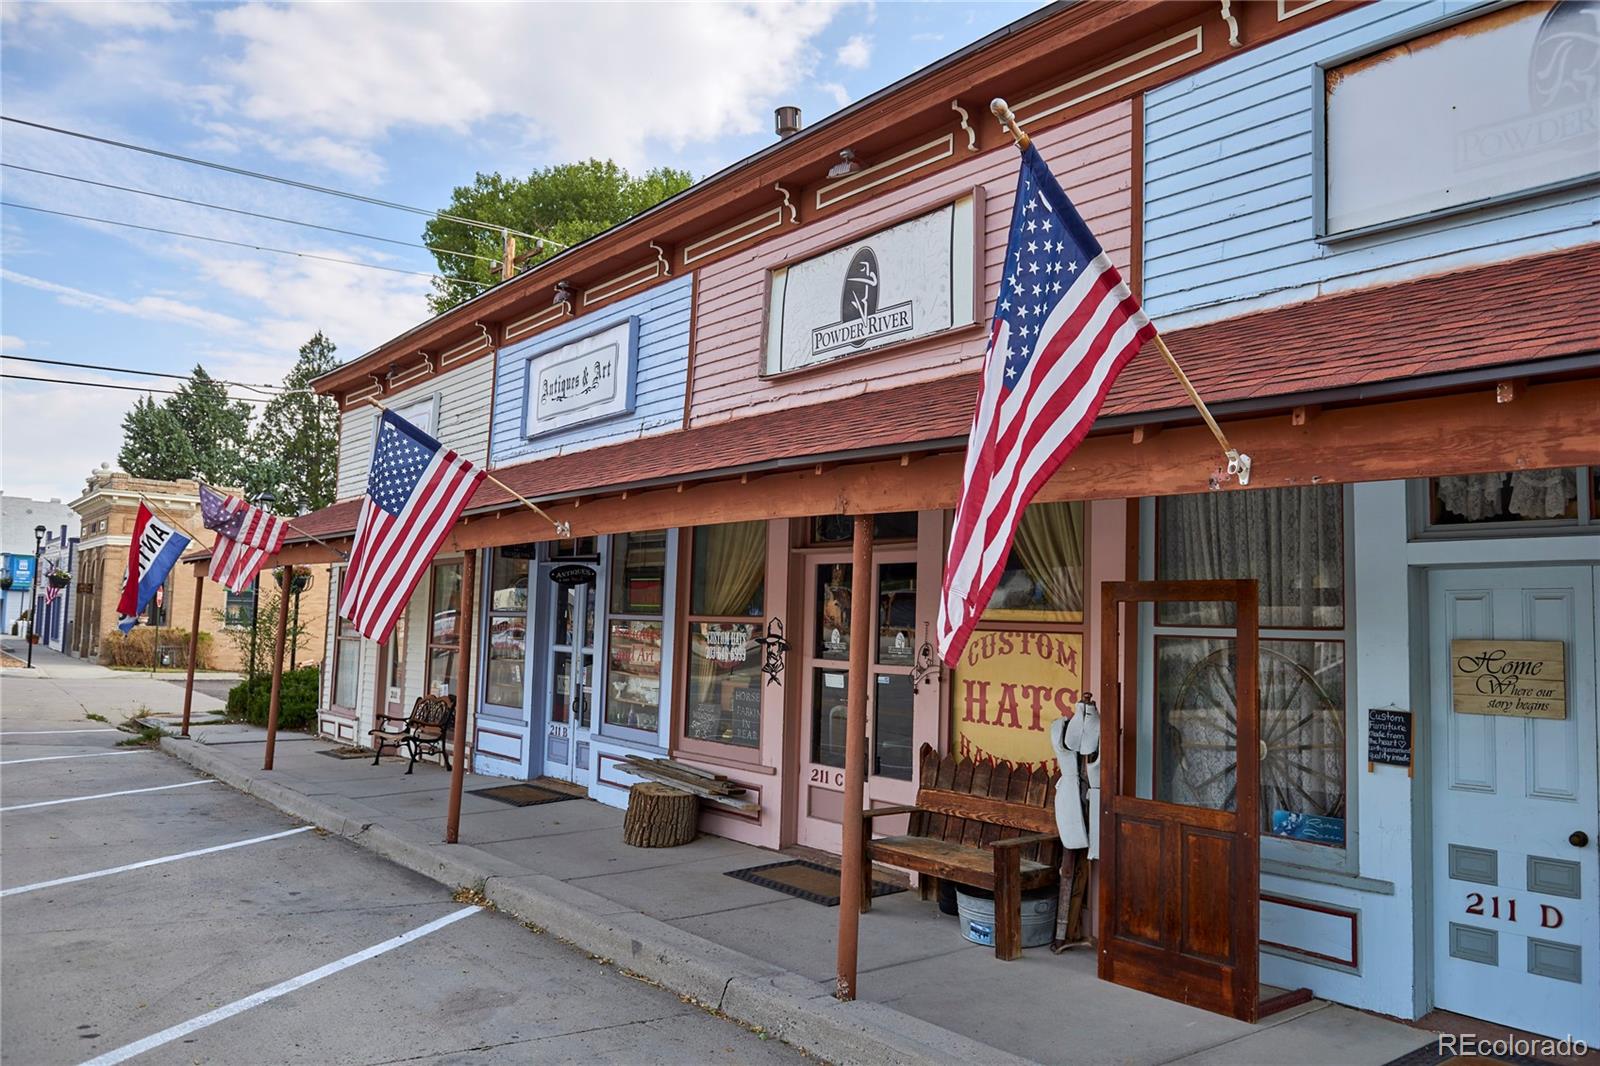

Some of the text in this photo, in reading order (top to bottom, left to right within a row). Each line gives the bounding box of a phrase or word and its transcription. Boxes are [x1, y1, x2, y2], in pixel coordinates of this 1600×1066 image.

[815, 310, 909, 349] POWDER RIVER
[541, 360, 611, 404] Antiques & Art
[555, 568, 592, 578] ANTIQUES
[638, 647, 655, 663] Art
[967, 630, 1078, 678] CUSTOM
[1457, 649, 1544, 676] Home
[1475, 673, 1556, 698] Where our
[961, 679, 1079, 732] HATS
[1369, 710, 1405, 723] Custom
[1486, 697, 1551, 715] story begins
[811, 769, 844, 787] 211 C
[1465, 892, 1564, 929] 211 D
